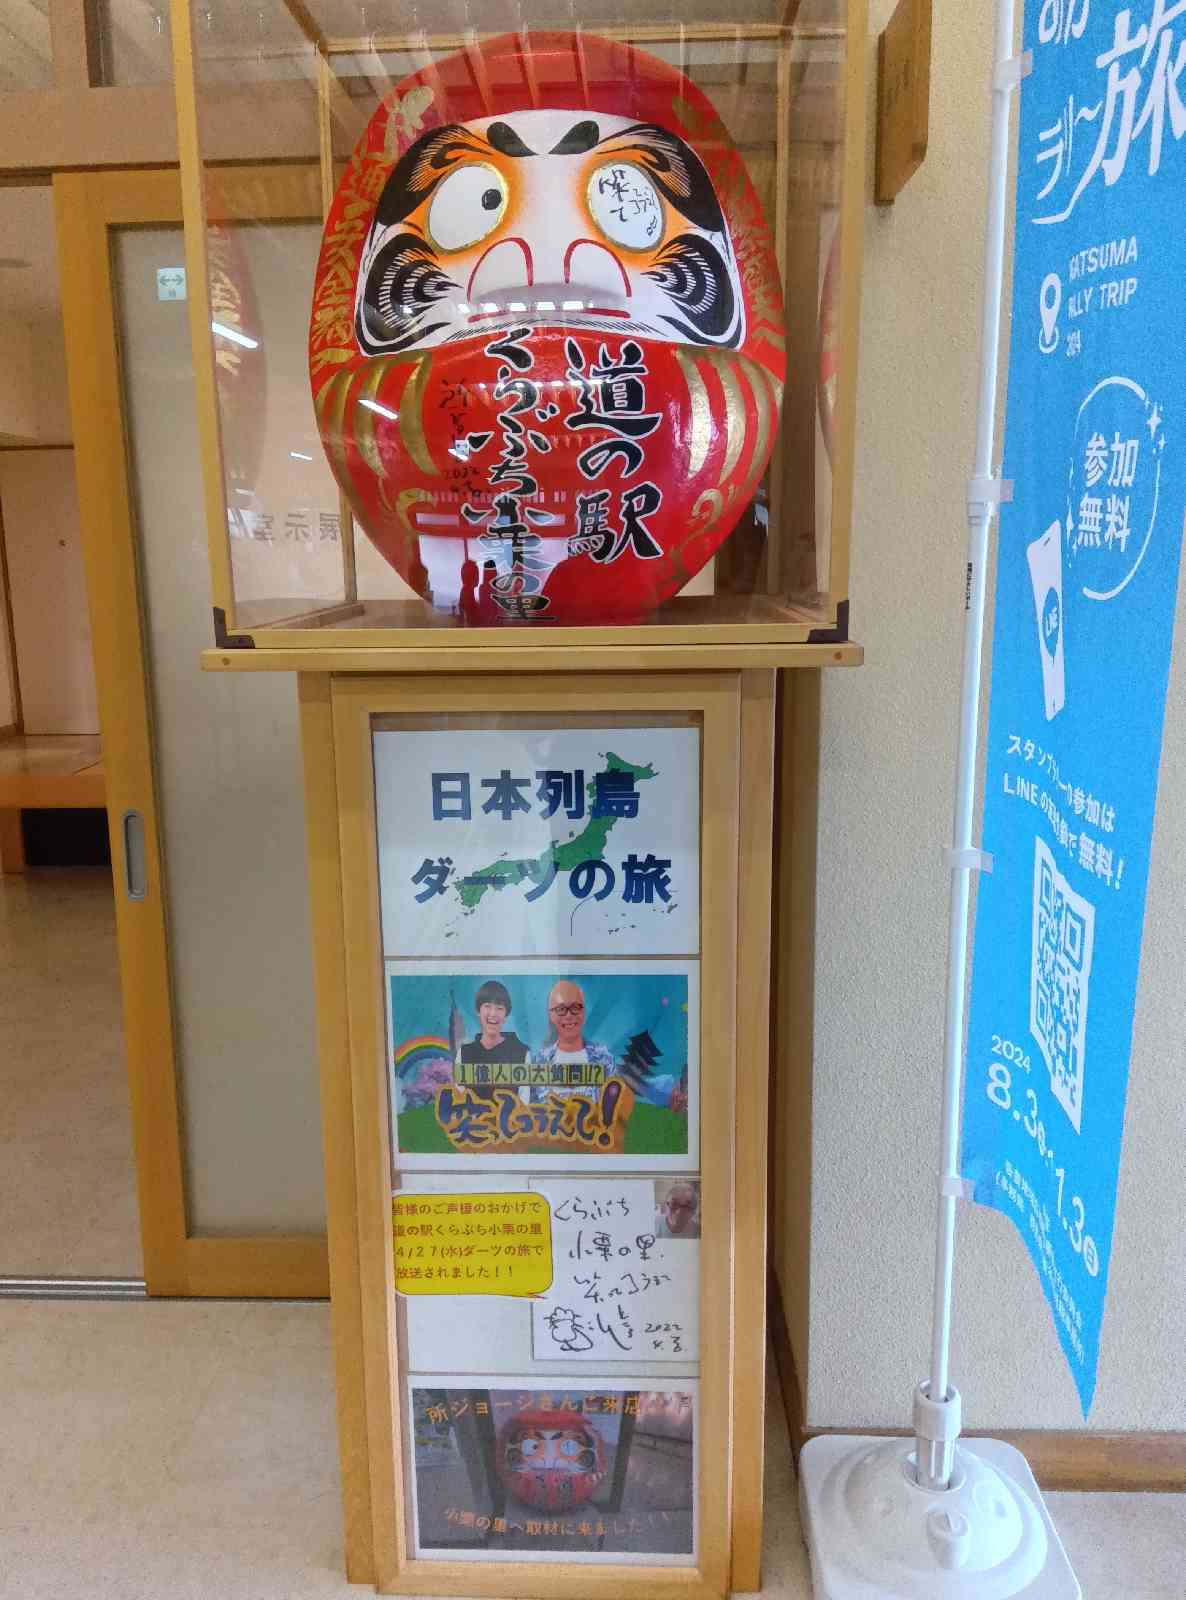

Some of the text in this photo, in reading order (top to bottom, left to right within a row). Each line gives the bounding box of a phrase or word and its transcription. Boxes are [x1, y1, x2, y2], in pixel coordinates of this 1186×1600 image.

[1100, 277, 1138, 310] TRIP
[460, 326, 555, 620] くらぶち小栗の里
[563, 336, 665, 565] 道の駅
[1084, 431, 1140, 489] 参加
[1077, 495, 1132, 553] 無料
[430, 769, 641, 822] 日本列島
[410, 853, 673, 904] ダーツの旅
[991, 1034, 1032, 1074] 2024
[393, 1223, 544, 1237] 道の駅くらぶち小栗の里
